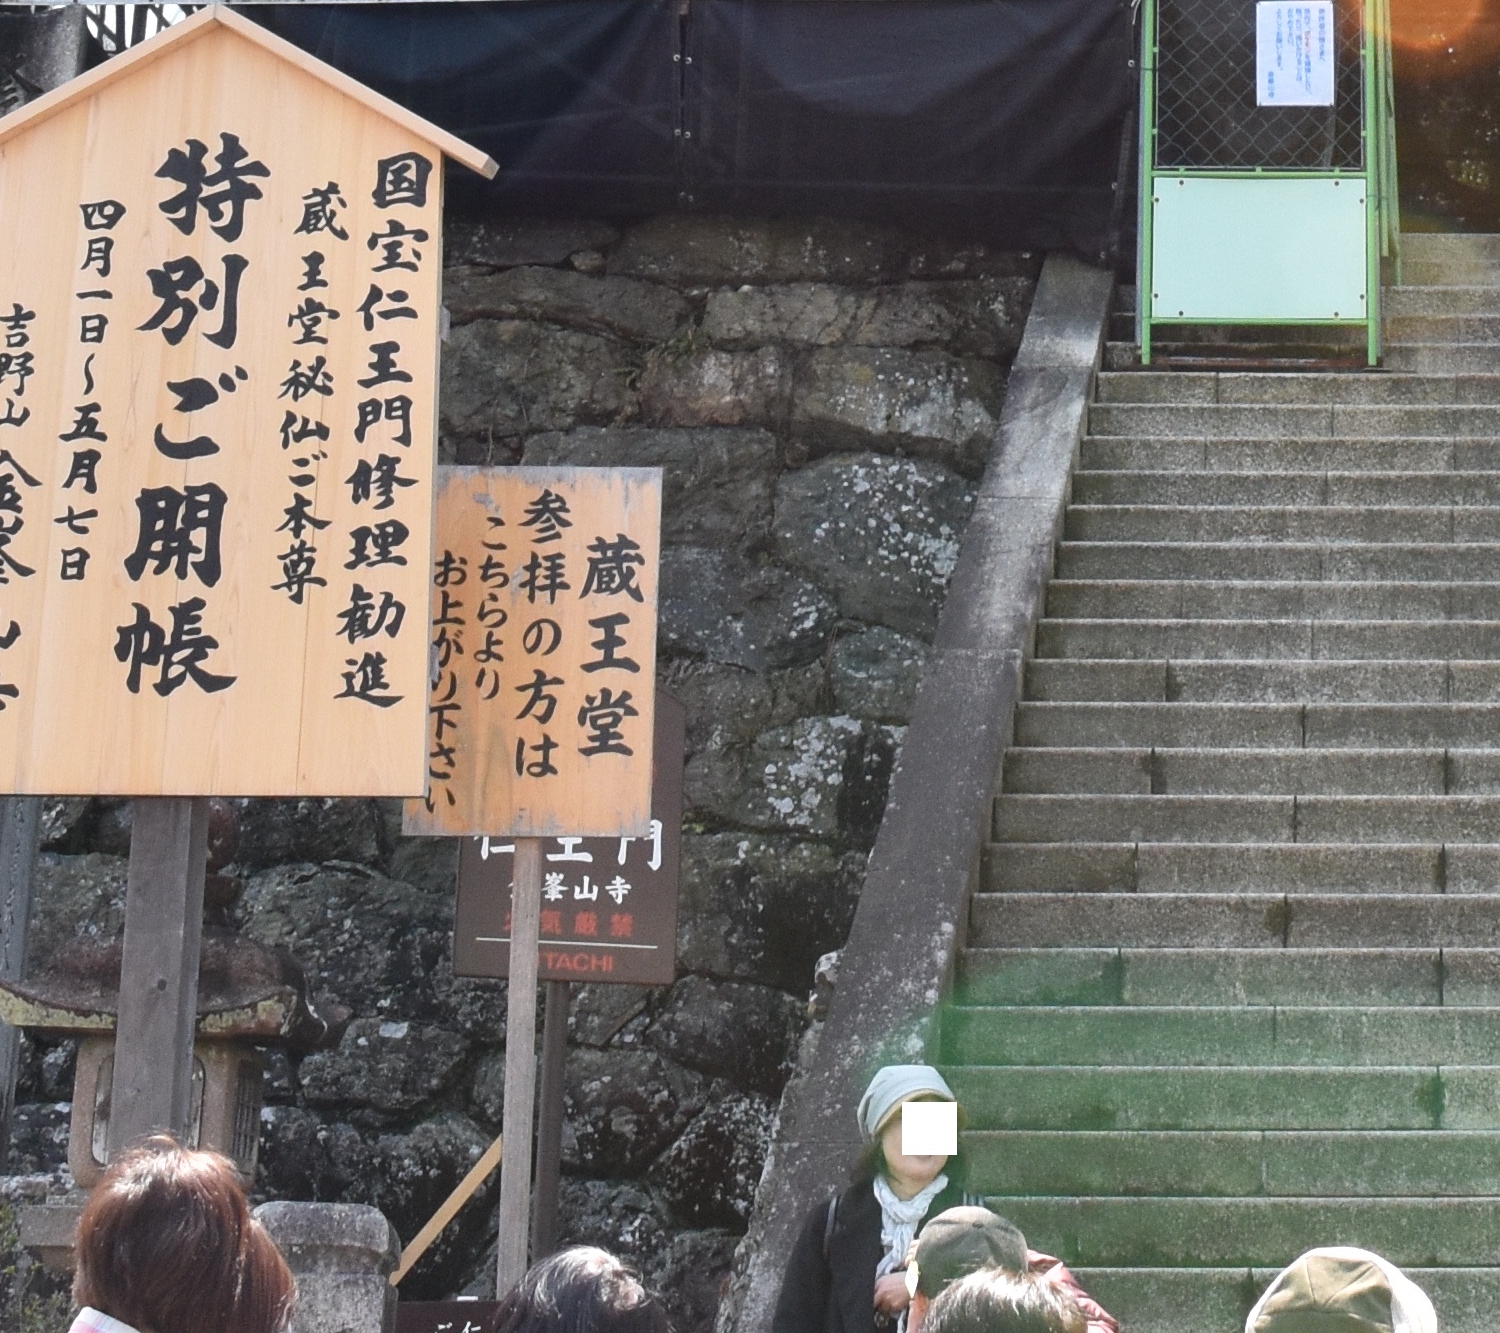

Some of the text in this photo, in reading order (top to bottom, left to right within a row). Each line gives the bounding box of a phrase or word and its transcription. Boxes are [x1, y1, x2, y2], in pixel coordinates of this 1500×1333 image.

[114, 132, 271, 697] 特別ご開帳
[334, 151, 434, 708] 国宝仁王門修理勧進
[426, 549, 468, 813] お上がり下さい
[473, 516, 510, 700] こちらより
[515, 488, 574, 779] 参拝の方は
[577, 533, 646, 757] 蔵王堂
[508, 871, 632, 905] 峯山寺
[537, 951, 614, 973] TACHI
